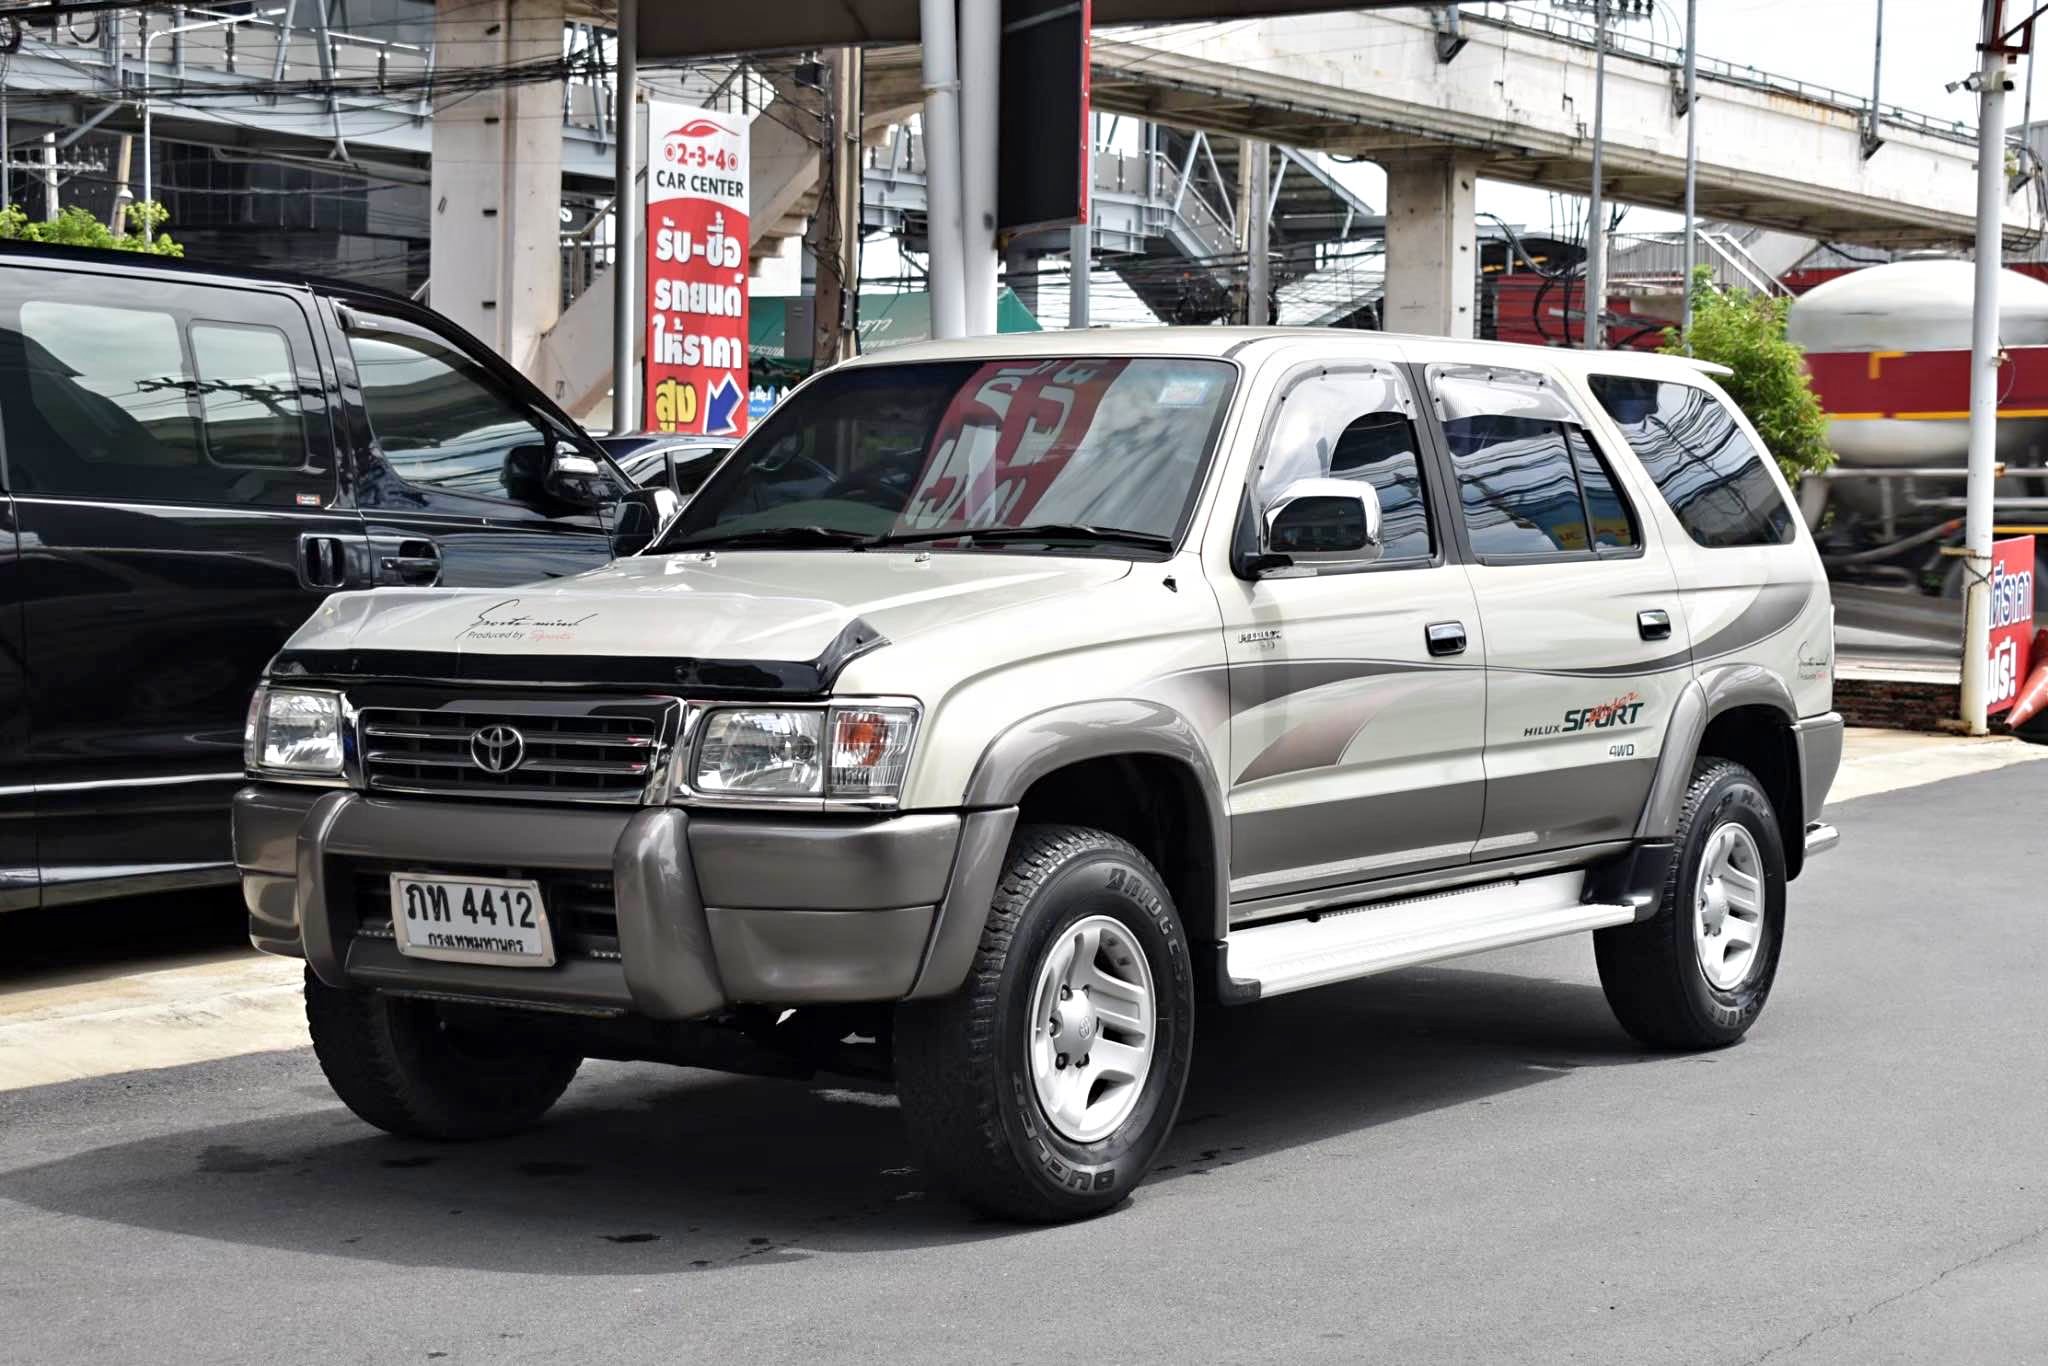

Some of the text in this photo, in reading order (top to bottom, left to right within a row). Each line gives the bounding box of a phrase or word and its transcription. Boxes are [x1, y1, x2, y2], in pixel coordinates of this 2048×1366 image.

[677, 143, 726, 170] 2-3-4
[656, 169, 744, 198] CAR CENTER
[654, 272, 744, 317] รถยนต์
[652, 313, 742, 370] ให้ราคา
[655, 377, 697, 433] สูง
[466, 630, 512, 640] Produced
[514, 630, 525, 642] by
[1524, 702, 1645, 737] HILUX SPORT
[1609, 743, 1635, 757] 4WD
[406, 883, 536, 929] ภท 4412
[428, 932, 524, 953] กรงเทพมหานคร
